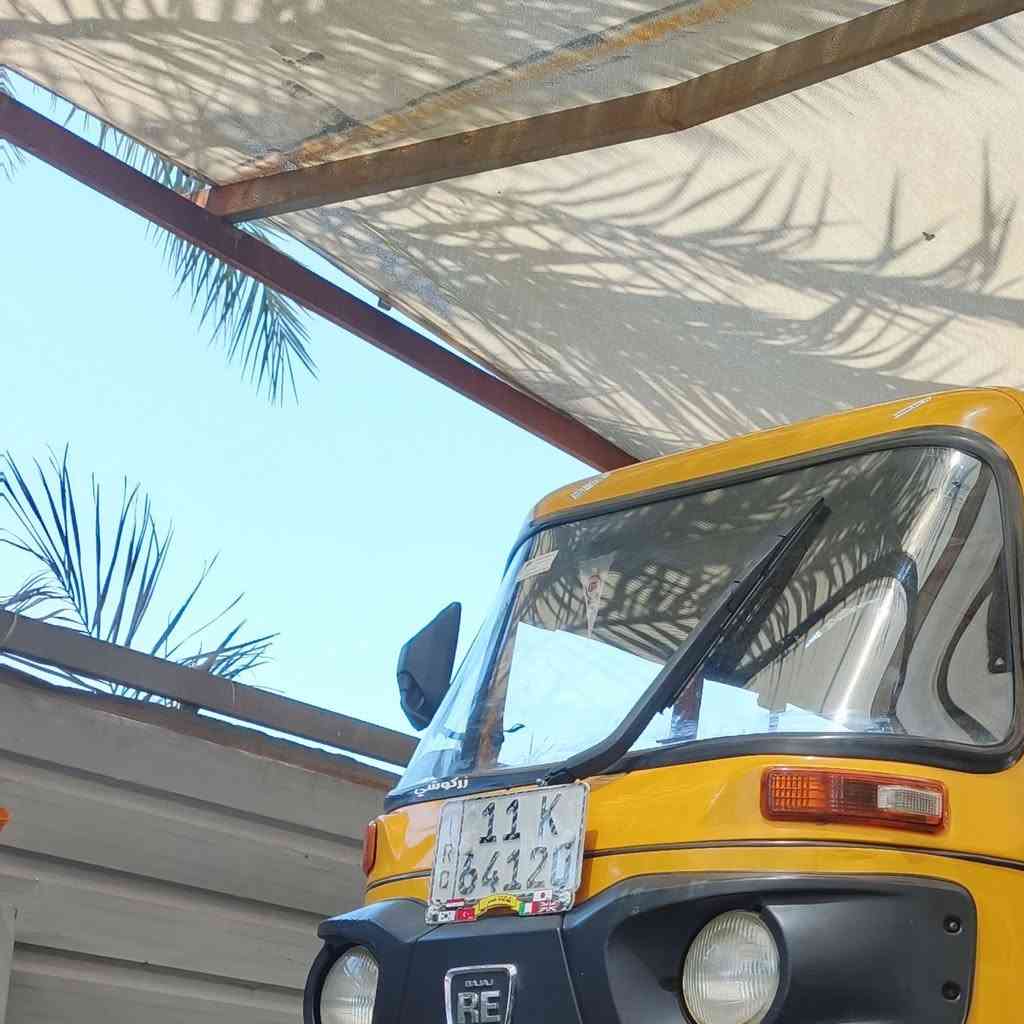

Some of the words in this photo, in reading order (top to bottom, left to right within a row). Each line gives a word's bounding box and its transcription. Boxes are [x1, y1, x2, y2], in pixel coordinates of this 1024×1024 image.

[479, 798, 521, 844] 11
[537, 792, 562, 838] K
[464, 978, 494, 988] BAJAJ
[457, 990, 501, 1024] RE
